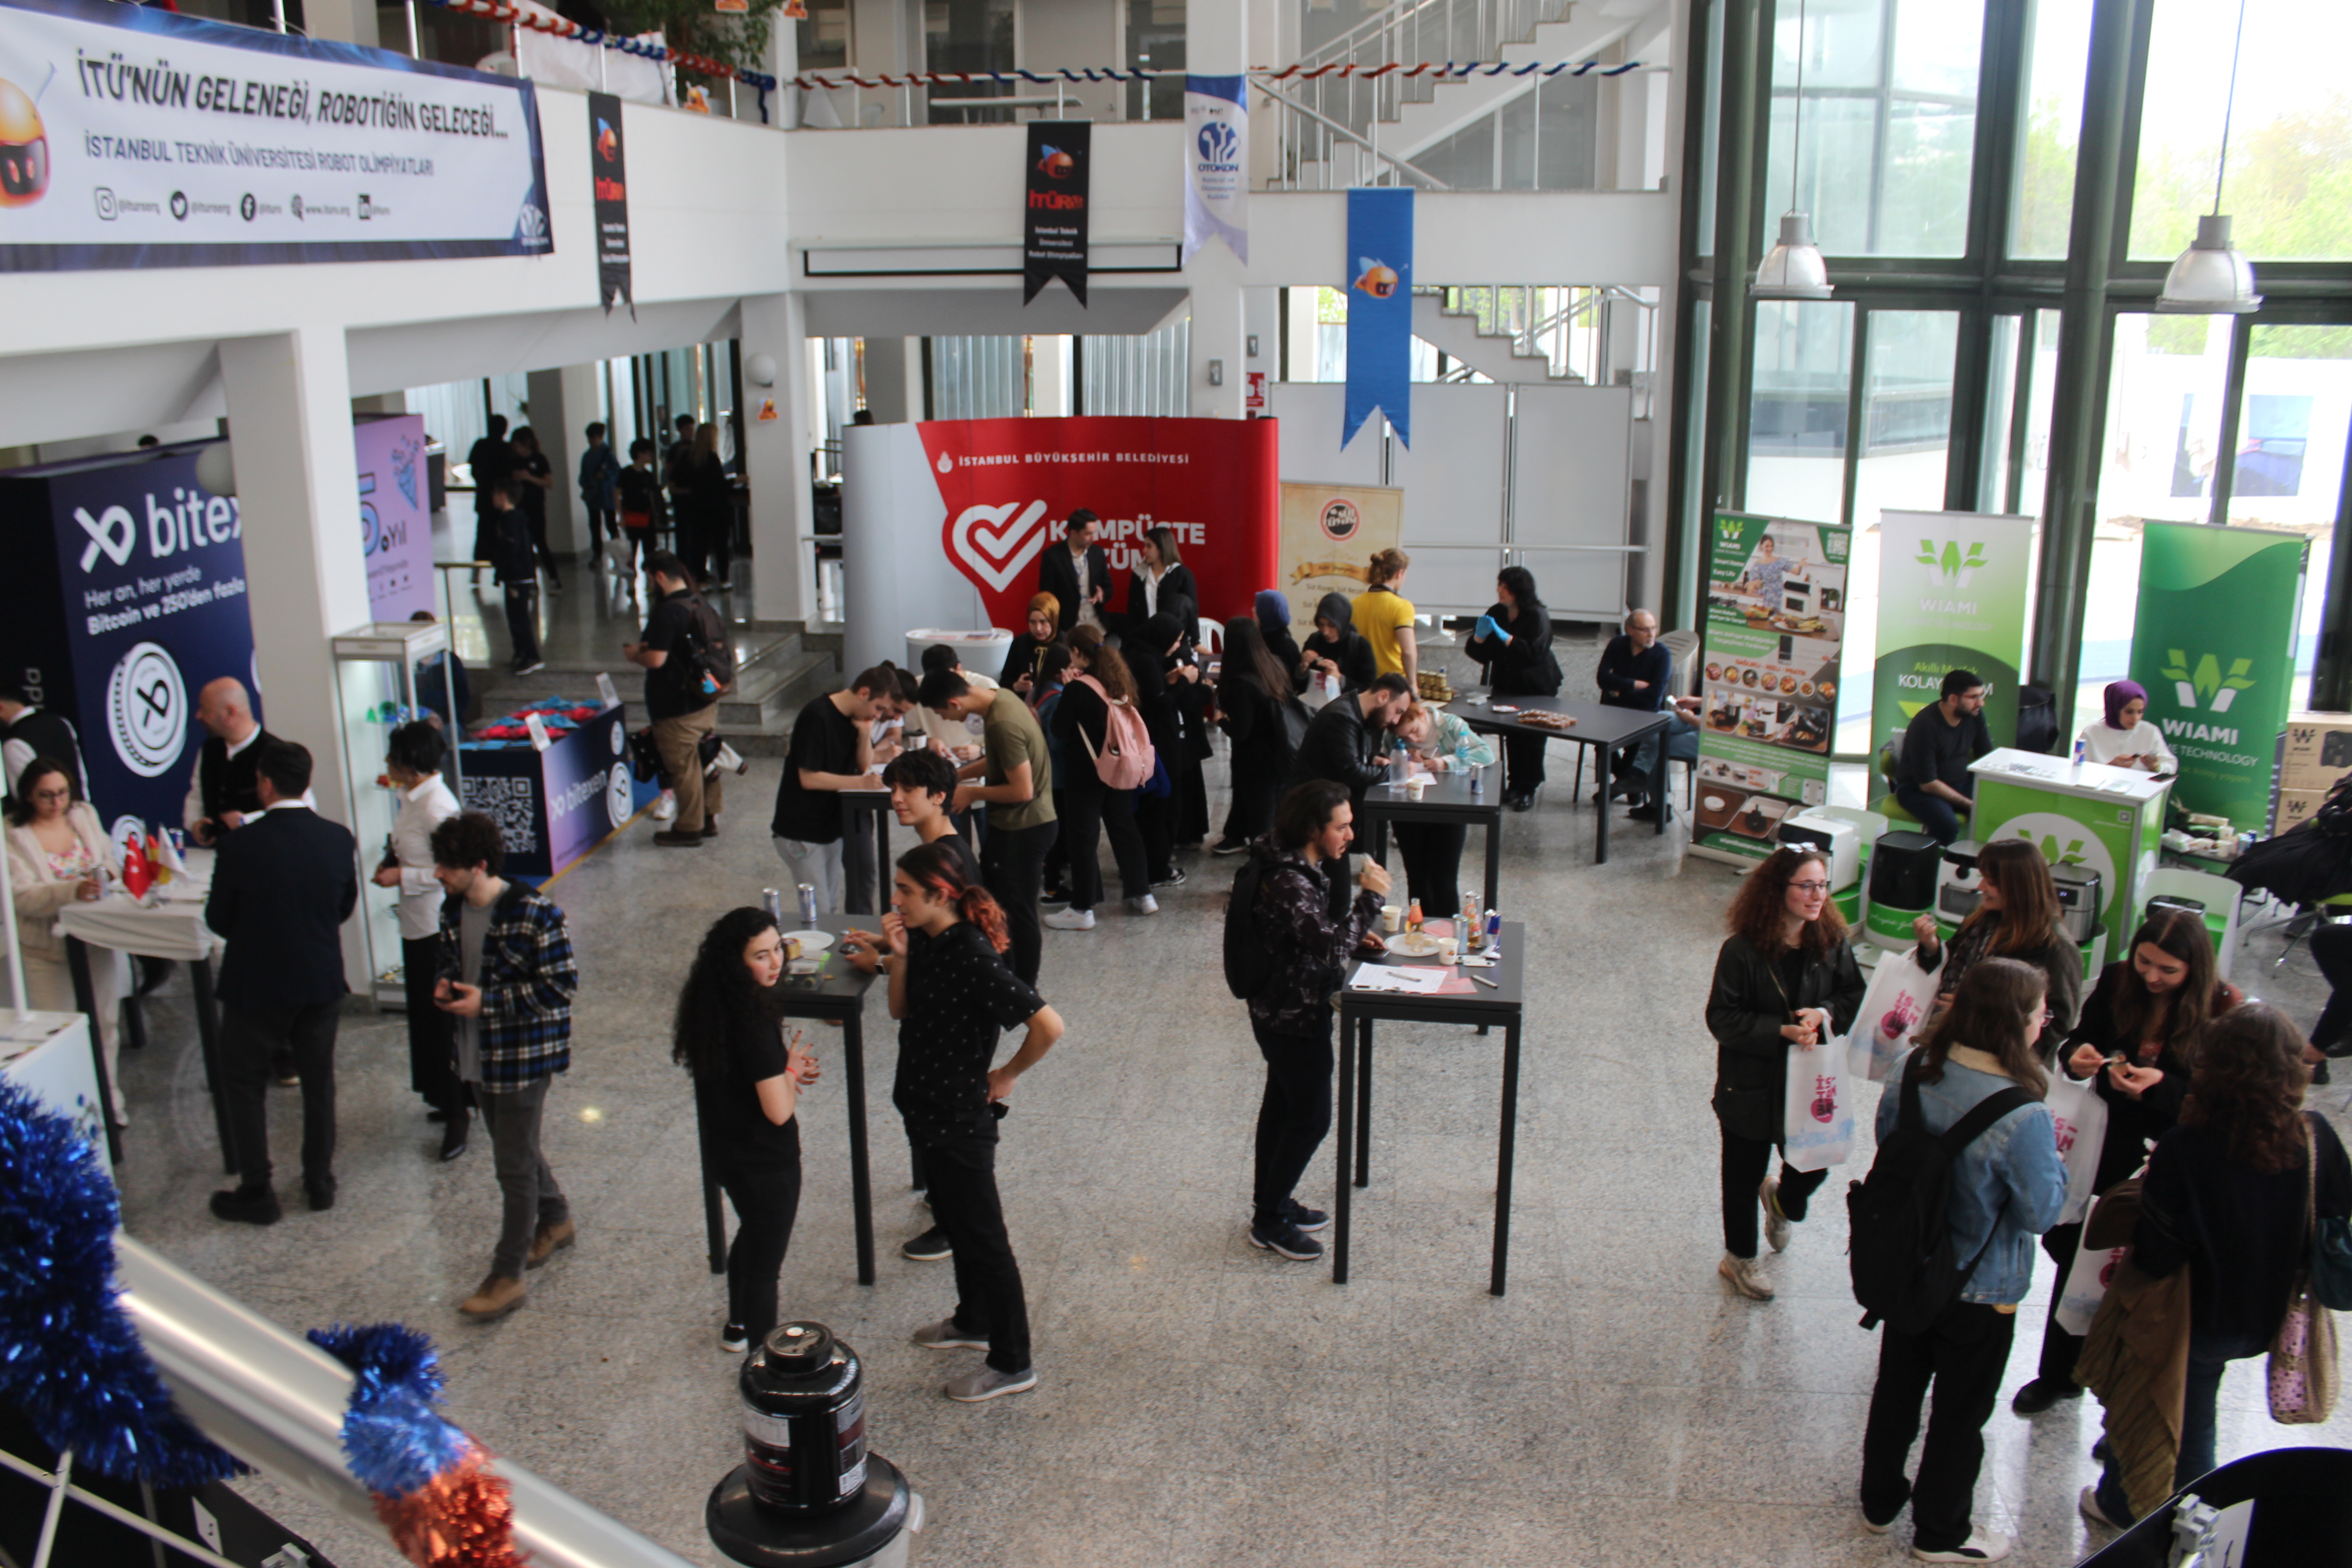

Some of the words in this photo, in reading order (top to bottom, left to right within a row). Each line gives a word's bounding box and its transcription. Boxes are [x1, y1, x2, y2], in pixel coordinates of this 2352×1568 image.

[78, 48, 191, 109] İTÜ'NÜN
[196, 76, 311, 125] GELENEĞİ,
[318, 91, 416, 130] ROBOTİĞİN
[420, 103, 509, 139] GELECEĞİ...
[85, 128, 173, 163] İSTANBUL
[175, 140, 229, 166] TEKNİK
[229, 141, 317, 171] ÜNİVERSİTESİ
[317, 152, 357, 172] ROBOT
[359, 151, 435, 176] OLİMPİYATLARI
[1198, 163, 1239, 172] OTOKON
[958, 453, 1019, 466] İSTANBUL
[1024, 451, 1110, 464] BÜYÜKŞEHİR
[1116, 451, 1189, 465] BELEDİYESİ
[1049, 513, 1205, 545] KMPÜTE
[84, 589, 112, 609] Her
[137, 577, 162, 595] her
[86, 605, 142, 636] Bitcoin
[142, 602, 161, 620] ve
[1920, 598, 1977, 615] WIAMI
[1935, 618, 1994, 632] TECHNOLOGY
[1898, 674, 1945, 690] KOLAY
[2162, 718, 2239, 746] WIAMI
[2180, 745, 2259, 767] TECHNOLOGY
